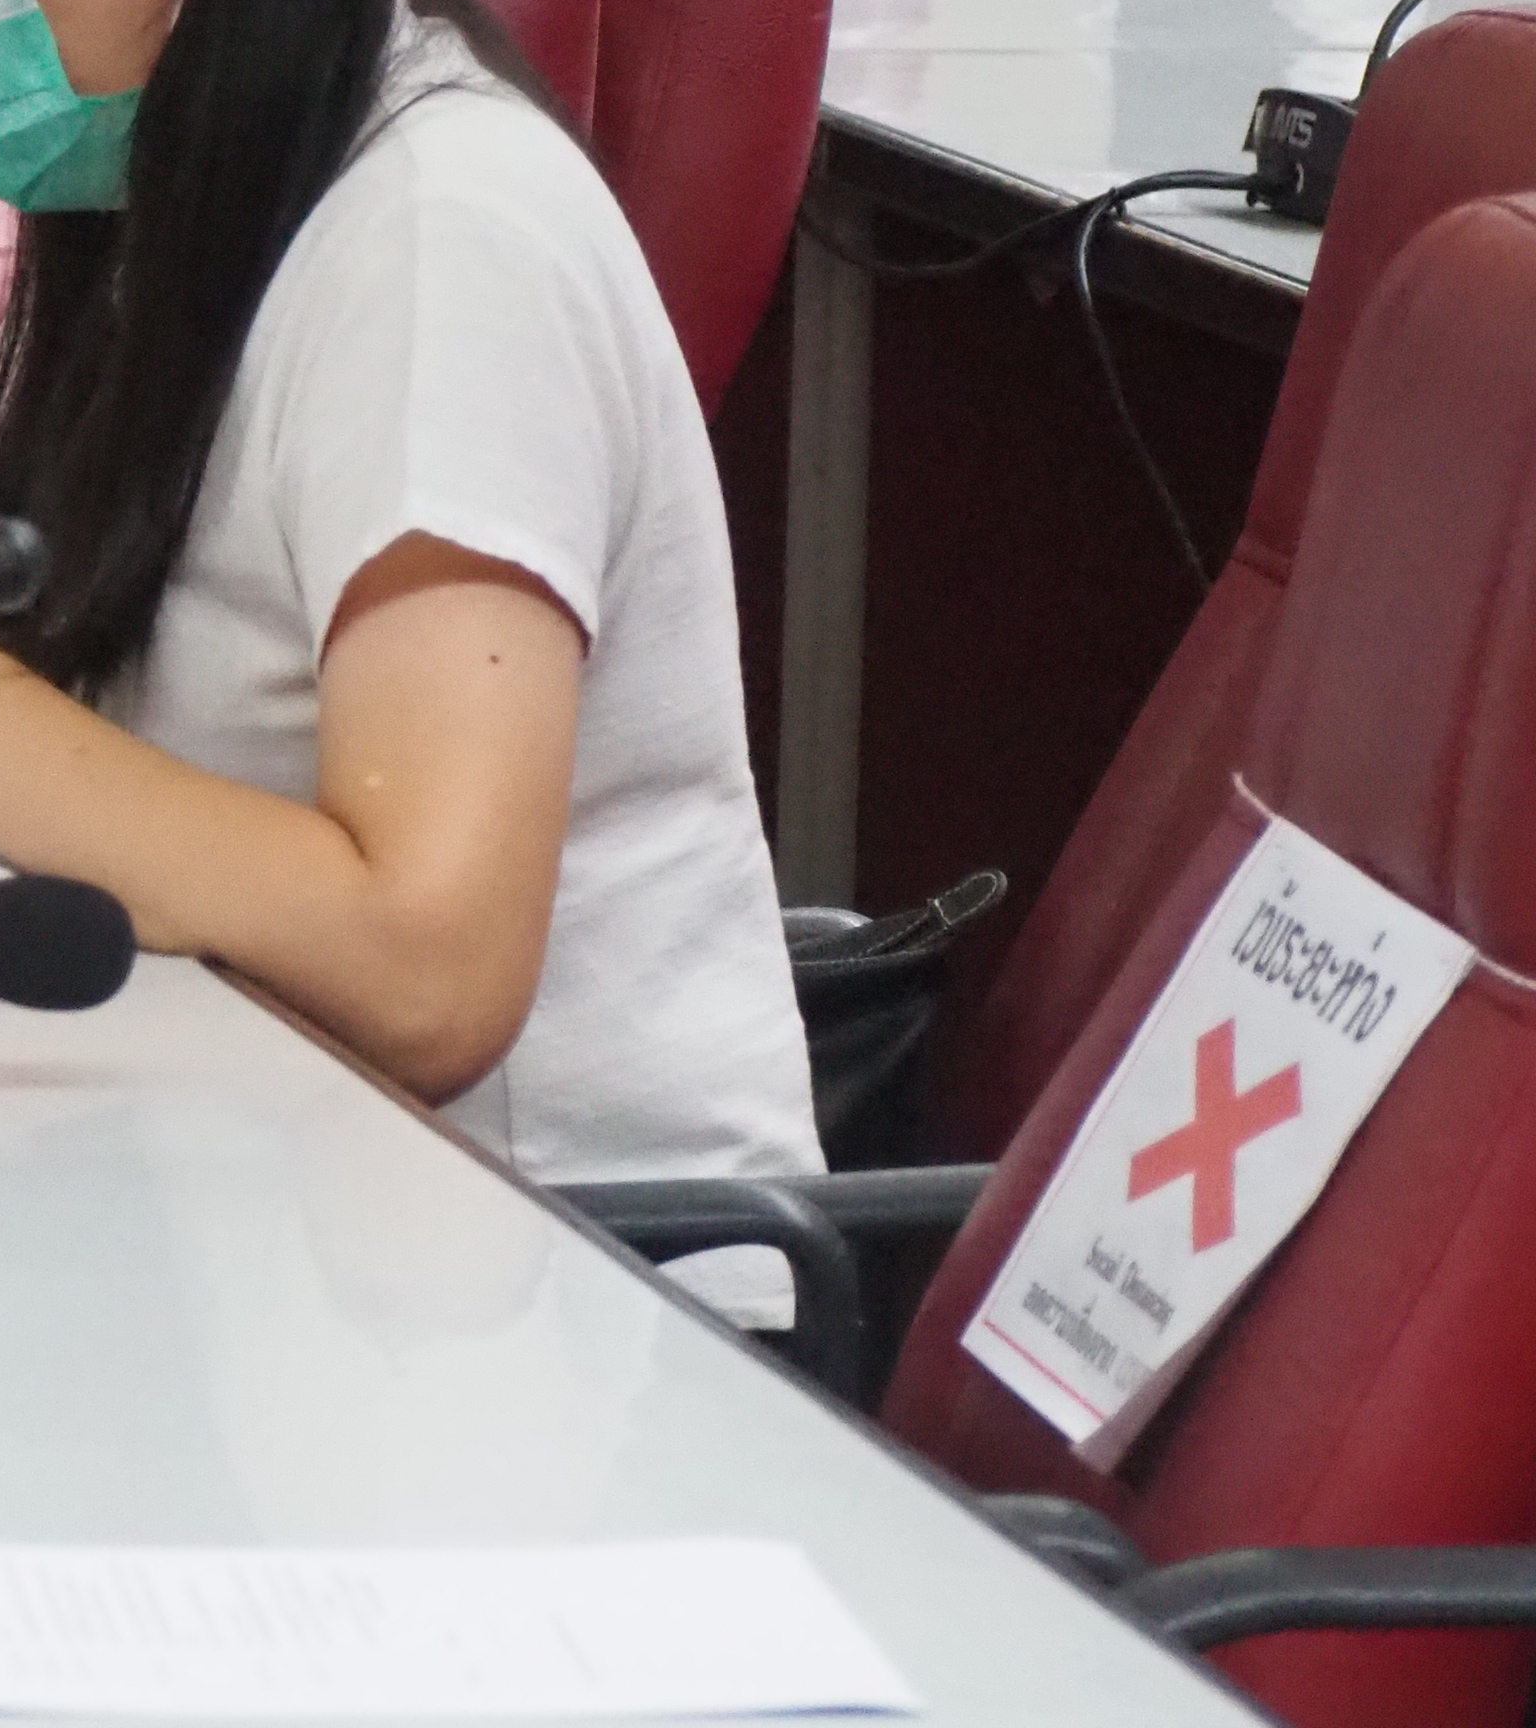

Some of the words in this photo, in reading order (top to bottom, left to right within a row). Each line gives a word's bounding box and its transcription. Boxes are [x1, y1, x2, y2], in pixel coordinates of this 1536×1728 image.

[1230, 877, 1397, 1043] เว้นระยะห่าง
